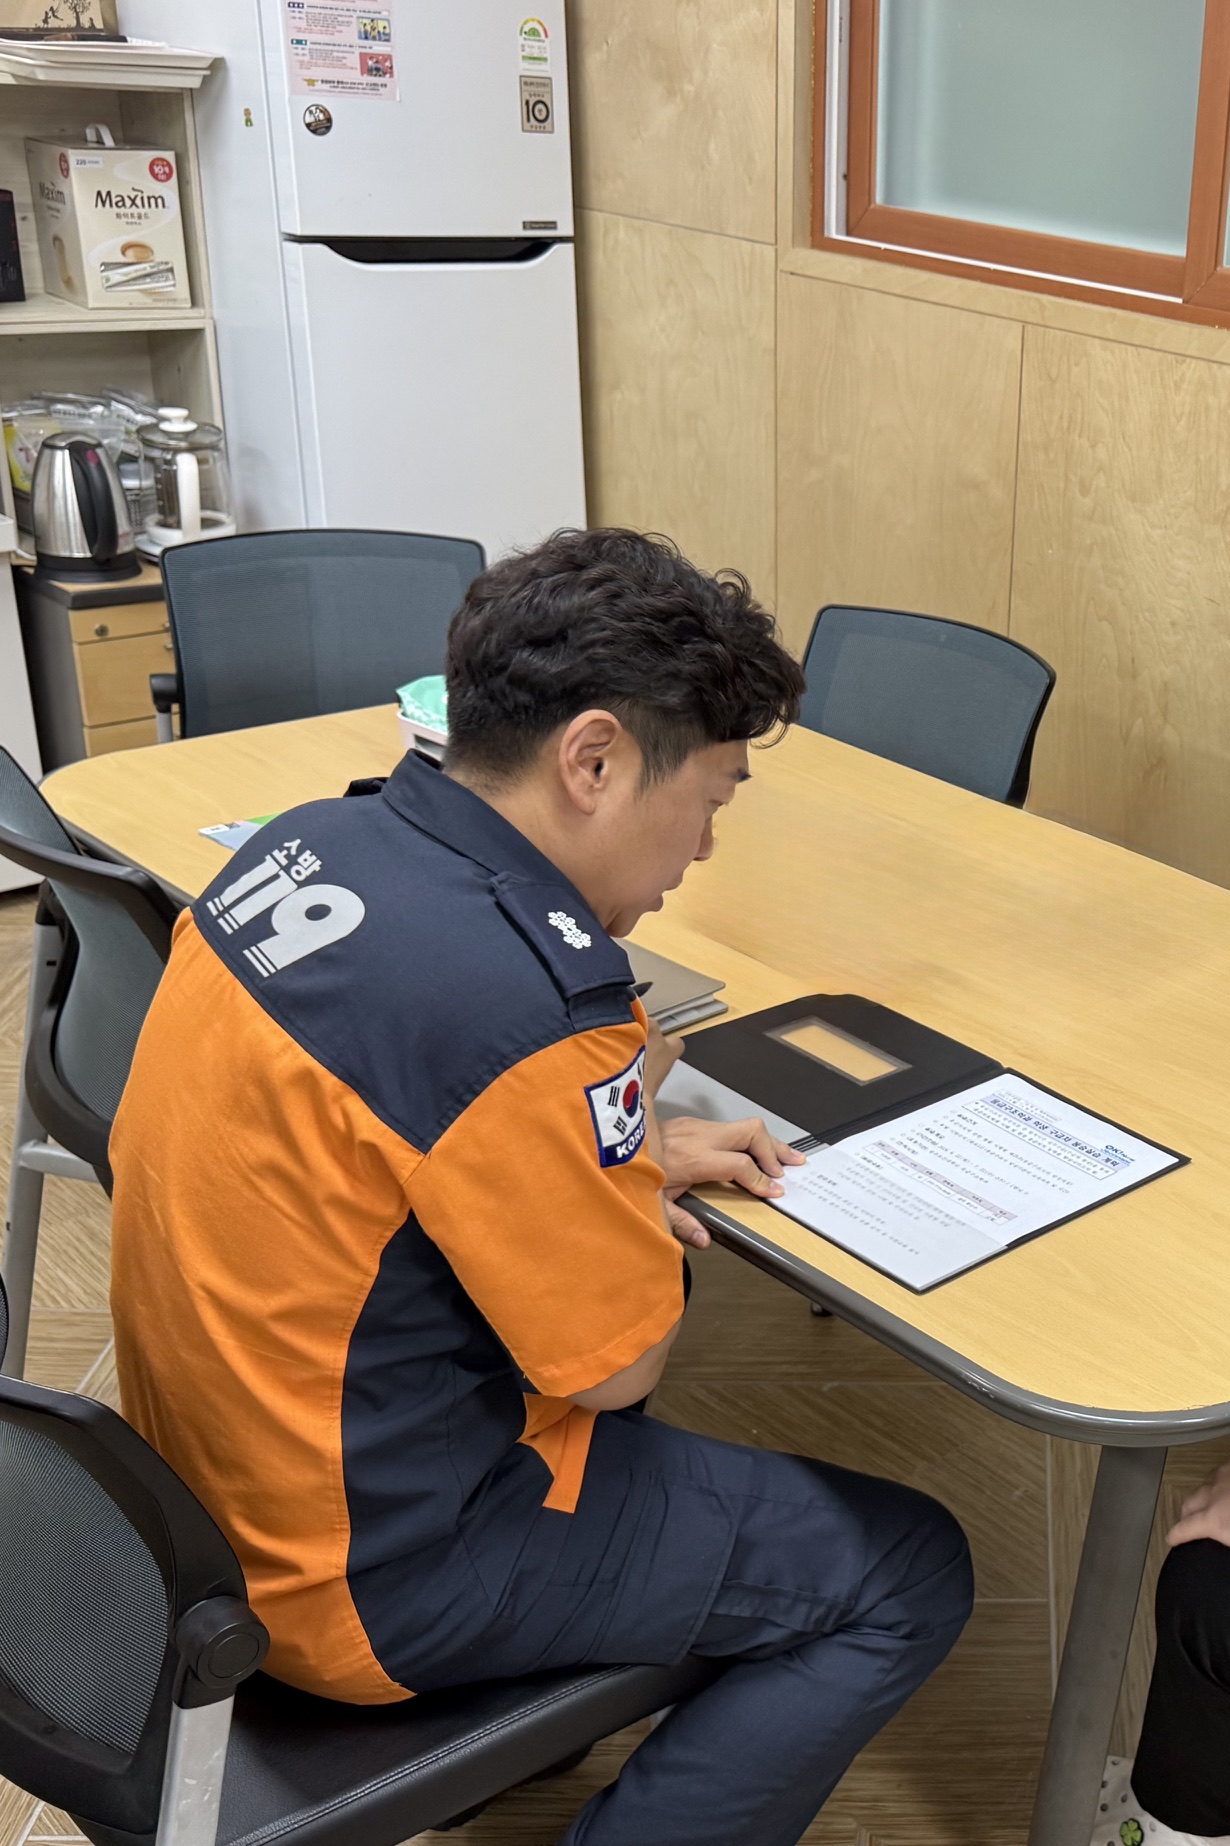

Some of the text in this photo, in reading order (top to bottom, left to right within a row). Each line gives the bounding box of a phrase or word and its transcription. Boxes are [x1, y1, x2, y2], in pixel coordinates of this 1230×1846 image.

[95, 187, 166, 209] Maxim
[272, 838, 323, 882] 소방
[206, 854, 366, 978] 119
[616, 1120, 645, 1158] KORE
